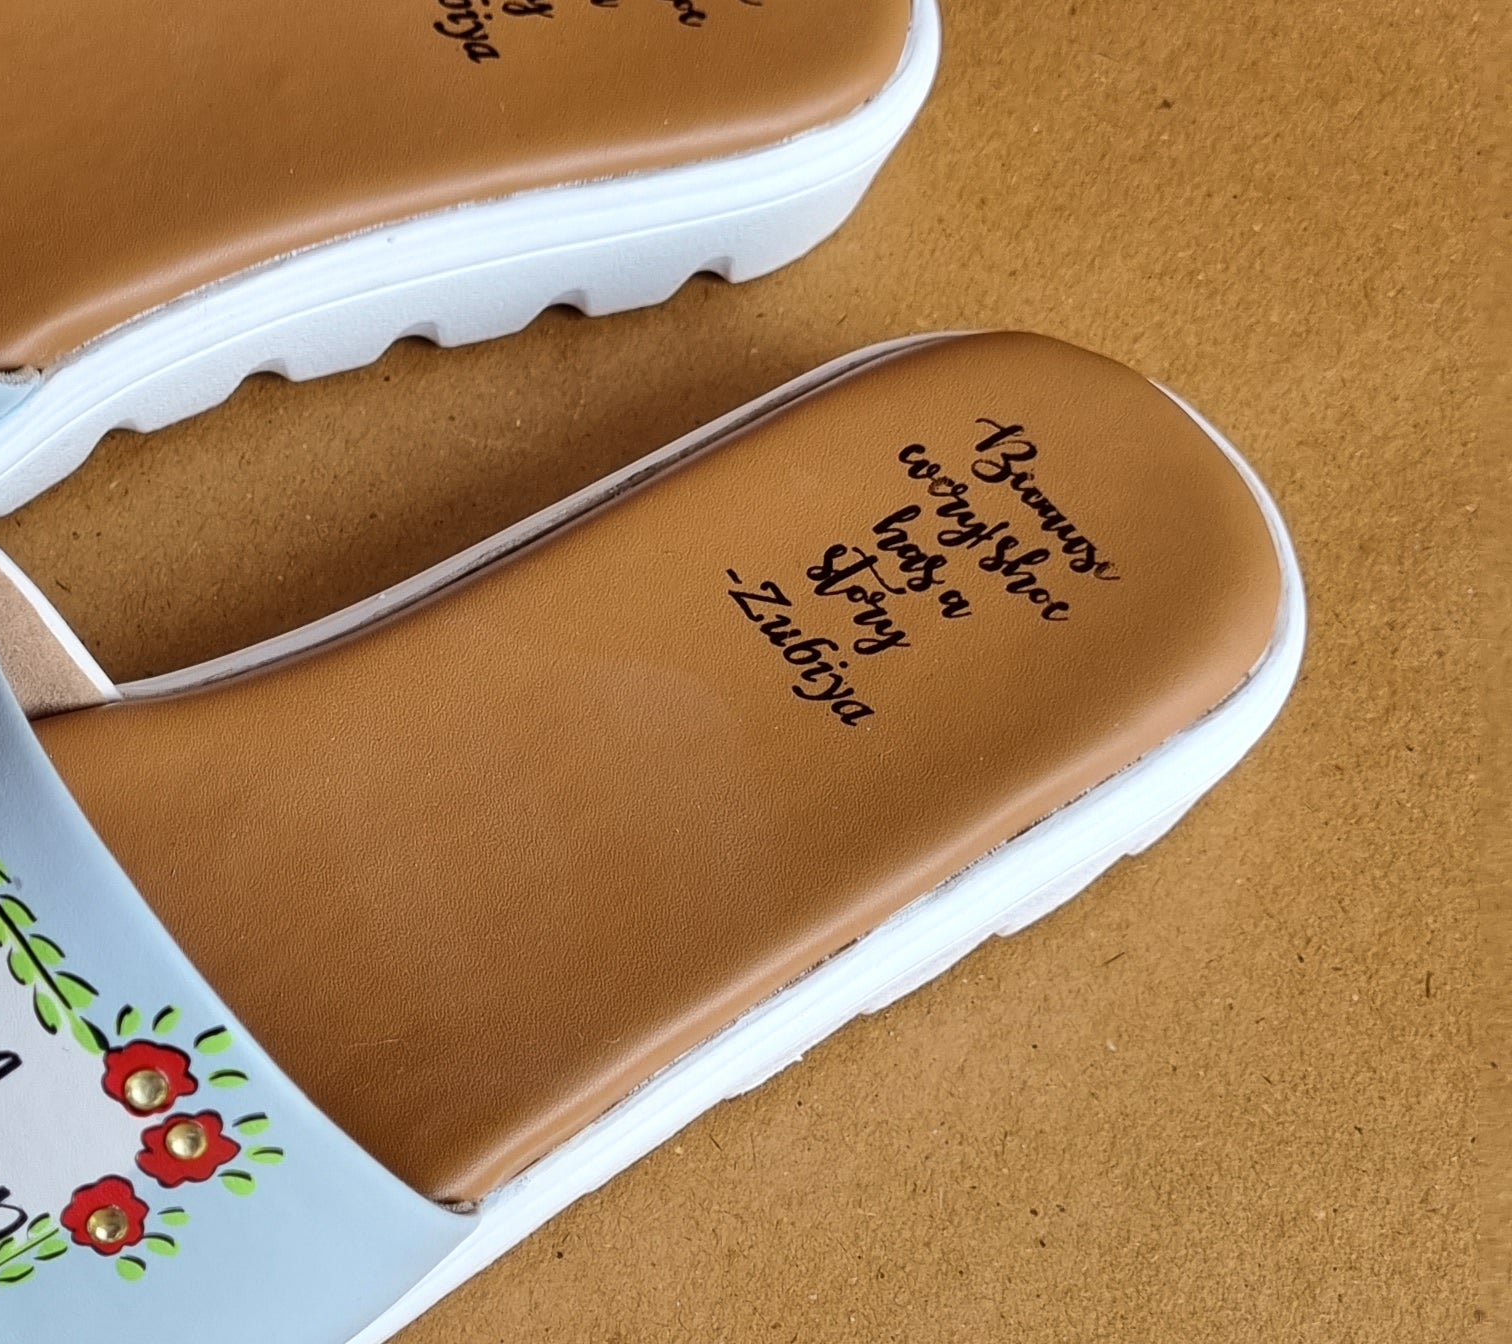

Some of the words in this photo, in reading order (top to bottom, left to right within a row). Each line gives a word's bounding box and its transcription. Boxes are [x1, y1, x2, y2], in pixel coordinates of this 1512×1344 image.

[806, 543, 911, 655] story
[872, 504, 947, 592] has
[938, 589, 972, 619] a
[978, 535, 1070, 622] shoe
[726, 568, 875, 727] -Zubiya
